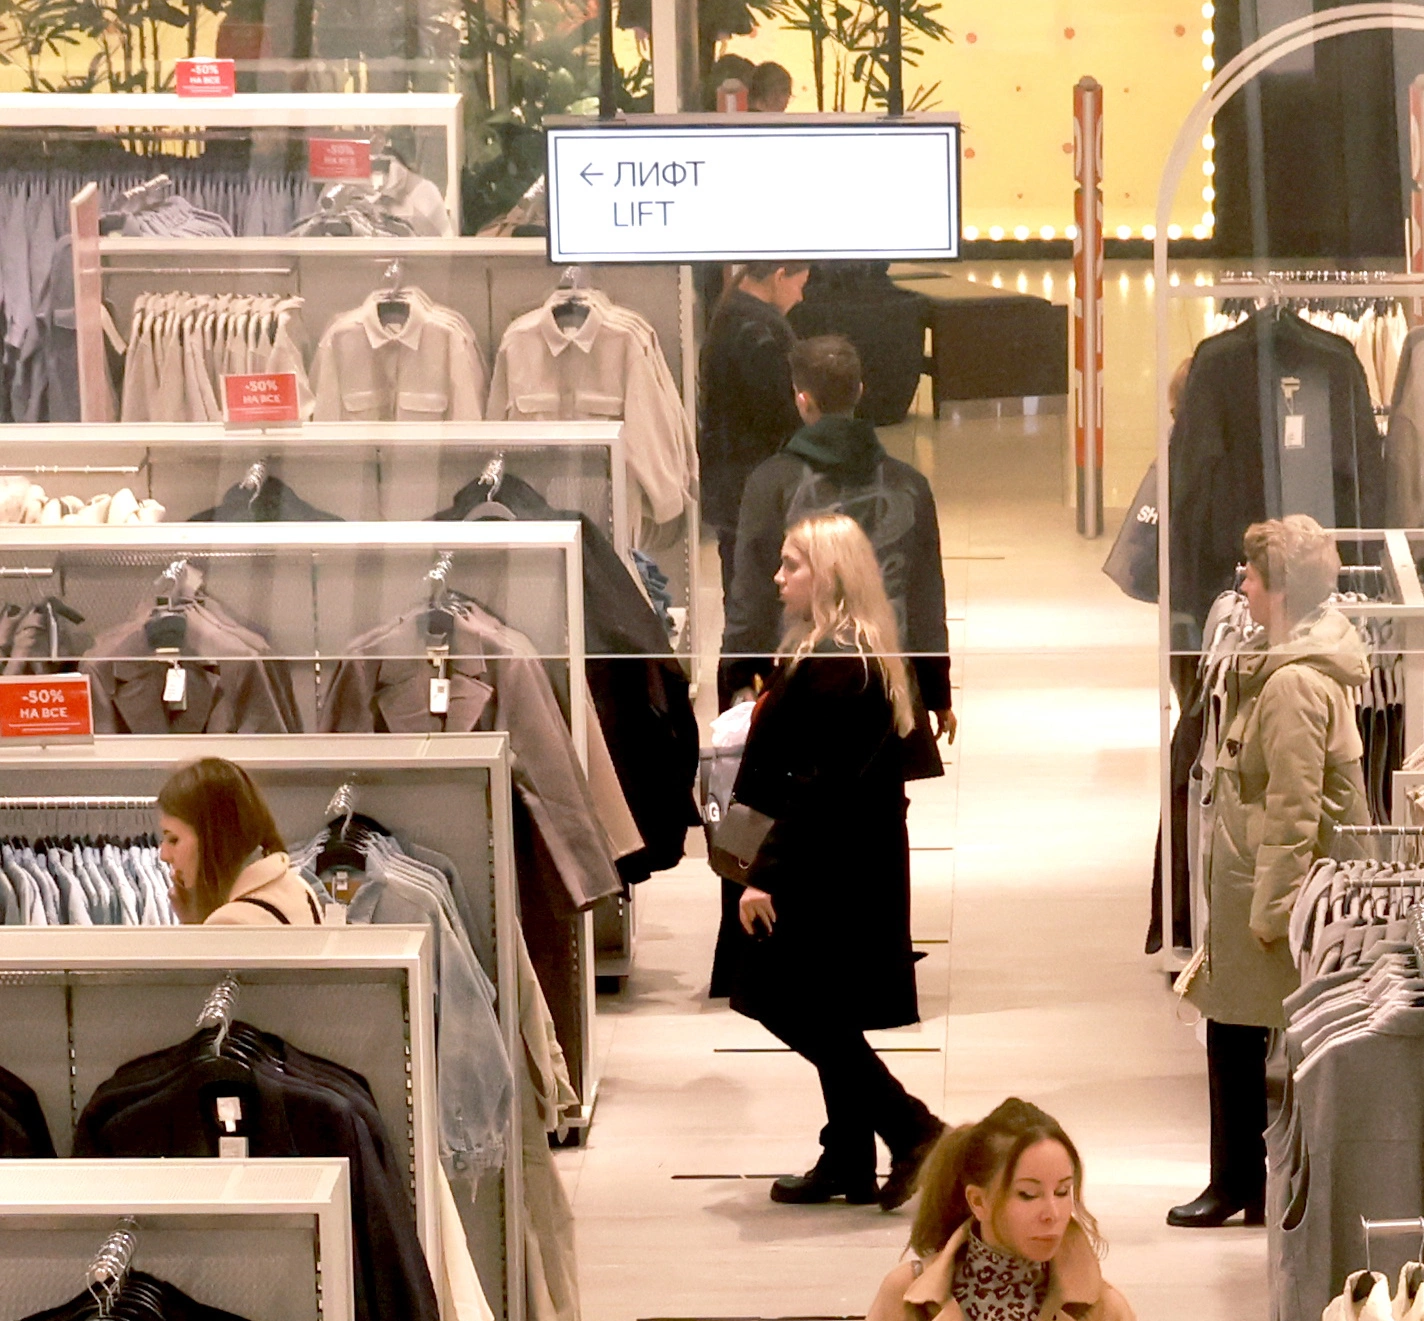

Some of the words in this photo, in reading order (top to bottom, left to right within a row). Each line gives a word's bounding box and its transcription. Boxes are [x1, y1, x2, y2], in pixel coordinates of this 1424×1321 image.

[190, 64, 219, 75] -50%
[613, 161, 706, 187] ЛИФТ
[613, 200, 675, 226] LIFT
[244, 380, 278, 392] -50%
[21, 689, 65, 704] -50%
[20, 707, 40, 719] НА
[41, 706, 68, 719] ВСЕ
